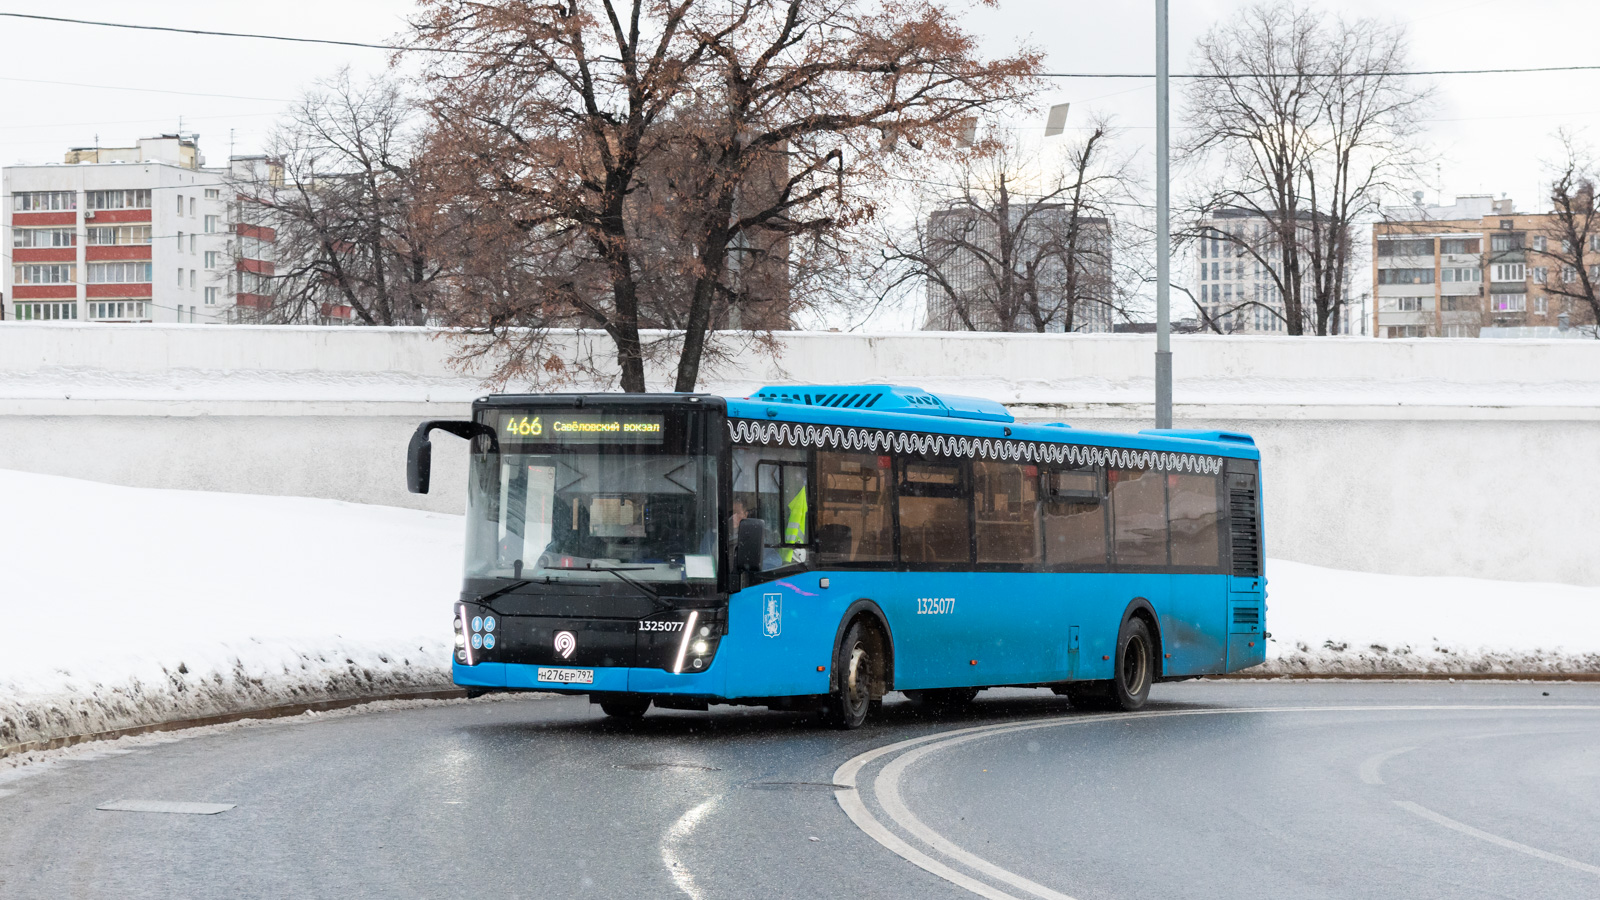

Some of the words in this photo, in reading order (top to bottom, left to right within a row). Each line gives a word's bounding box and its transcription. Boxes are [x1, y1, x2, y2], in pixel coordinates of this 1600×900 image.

[507, 417, 542, 435] 466
[554, 421, 620, 432] Савёловский
[624, 423, 660, 432] вокзал
[917, 598, 955, 614] 1325077
[638, 620, 685, 632] 1325077
[577, 670, 591, 680] 797
